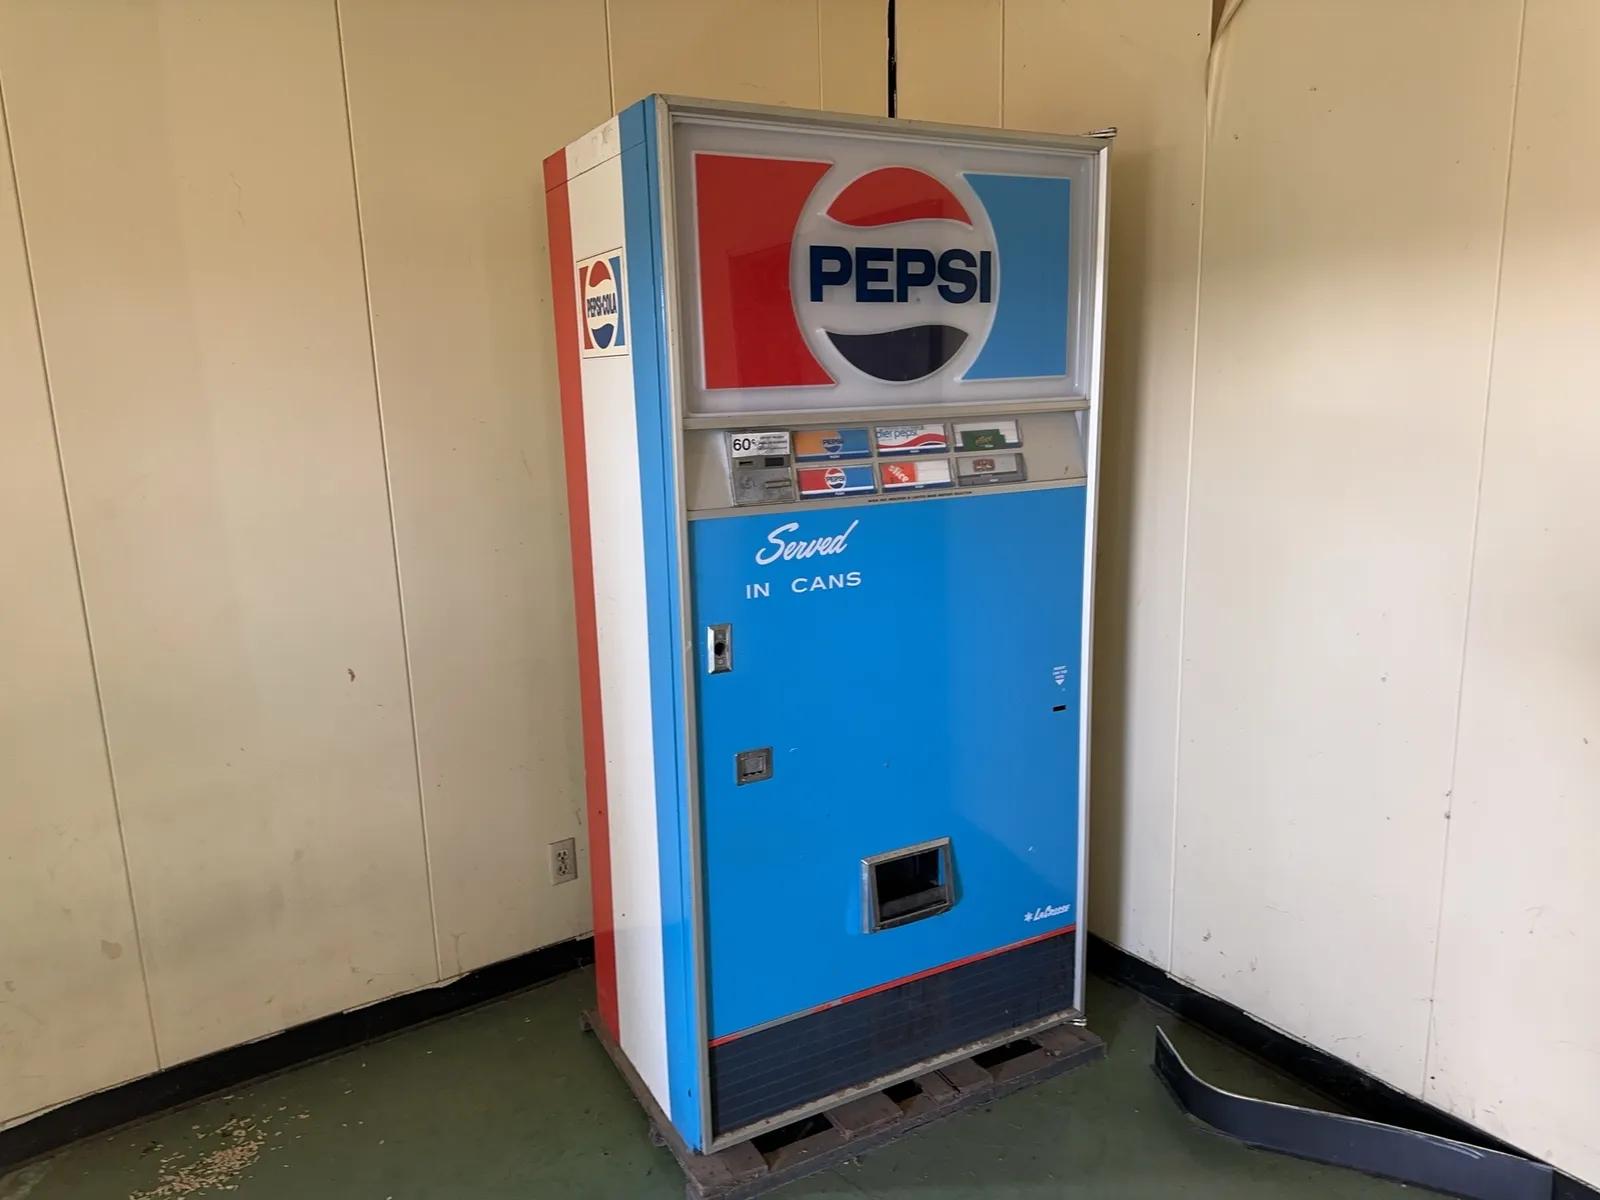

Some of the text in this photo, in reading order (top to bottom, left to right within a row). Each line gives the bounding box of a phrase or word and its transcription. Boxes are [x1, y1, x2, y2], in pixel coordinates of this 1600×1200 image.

[809, 245, 992, 304] PEPSI
[586, 293, 618, 318] PEPSI-COLA
[826, 475, 846, 483] PEPSI
[755, 519, 859, 565] Served
[746, 571, 862, 599] IN CANS
